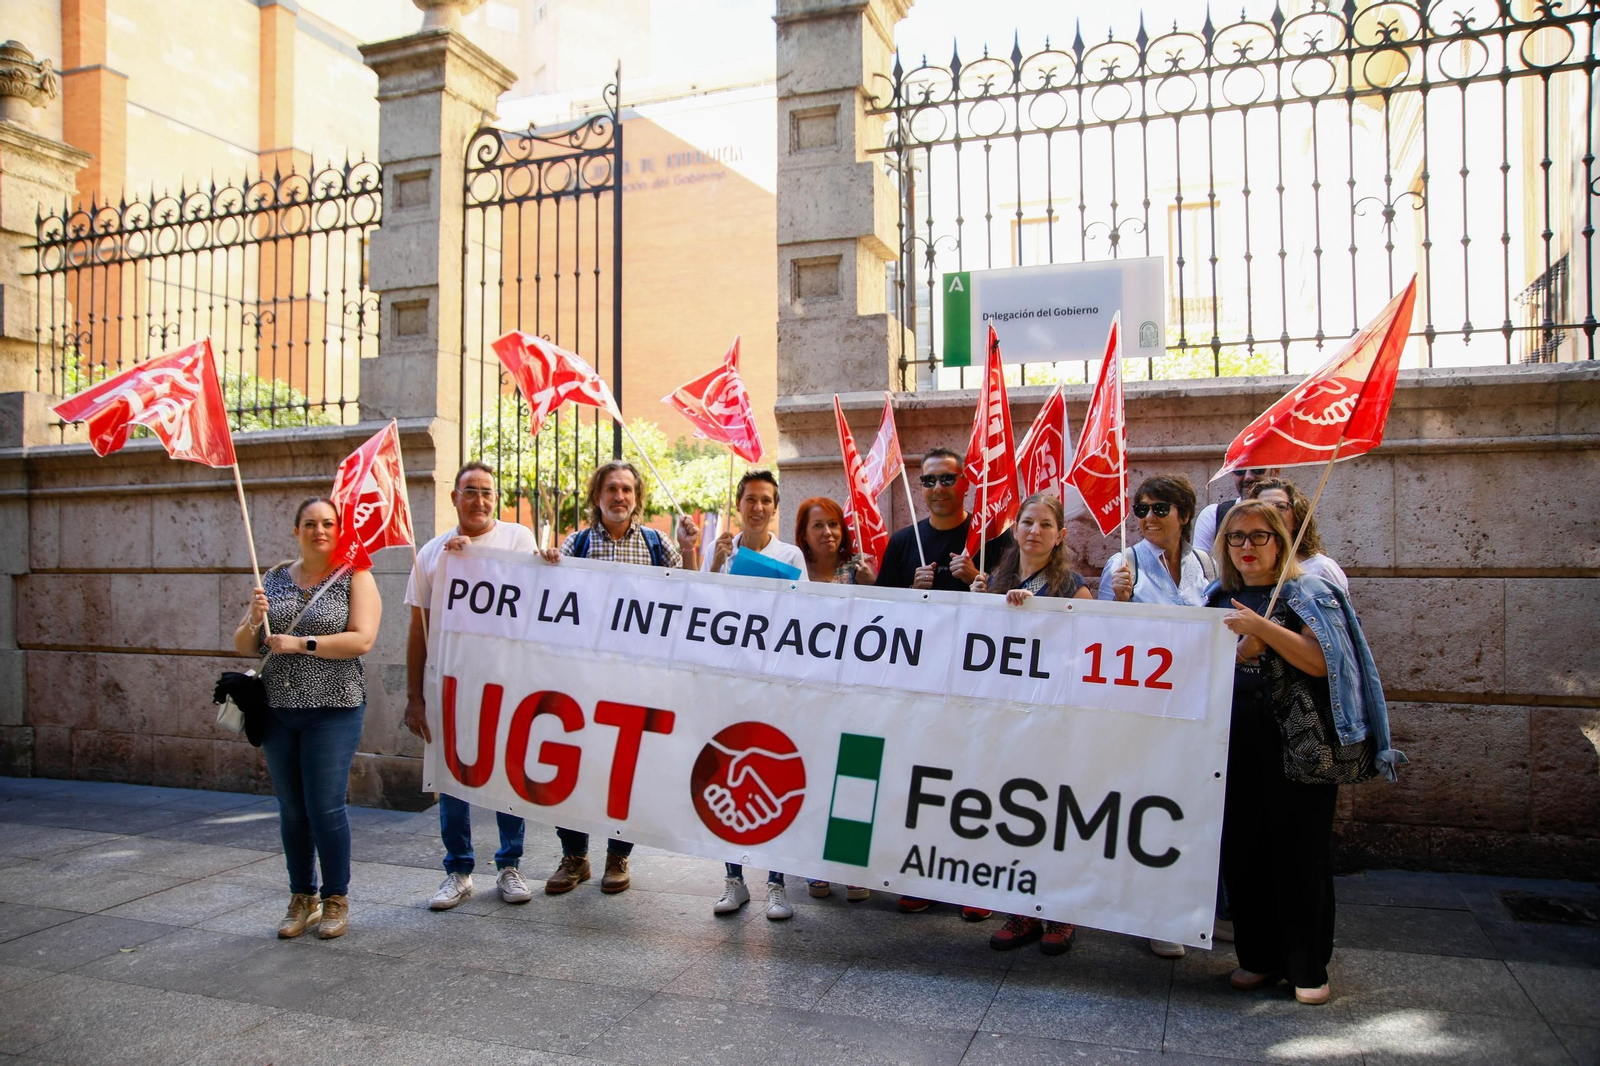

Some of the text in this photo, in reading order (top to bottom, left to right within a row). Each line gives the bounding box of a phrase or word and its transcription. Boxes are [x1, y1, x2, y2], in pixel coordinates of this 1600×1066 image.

[982, 306, 1099, 321] Delegación del Gobierno
[447, 578, 1174, 691] POR LA INTEGRACIÓN DEL 112
[442, 675, 676, 821] UGT
[904, 764, 1184, 869] FeSMC
[899, 845, 1038, 895] Almería
